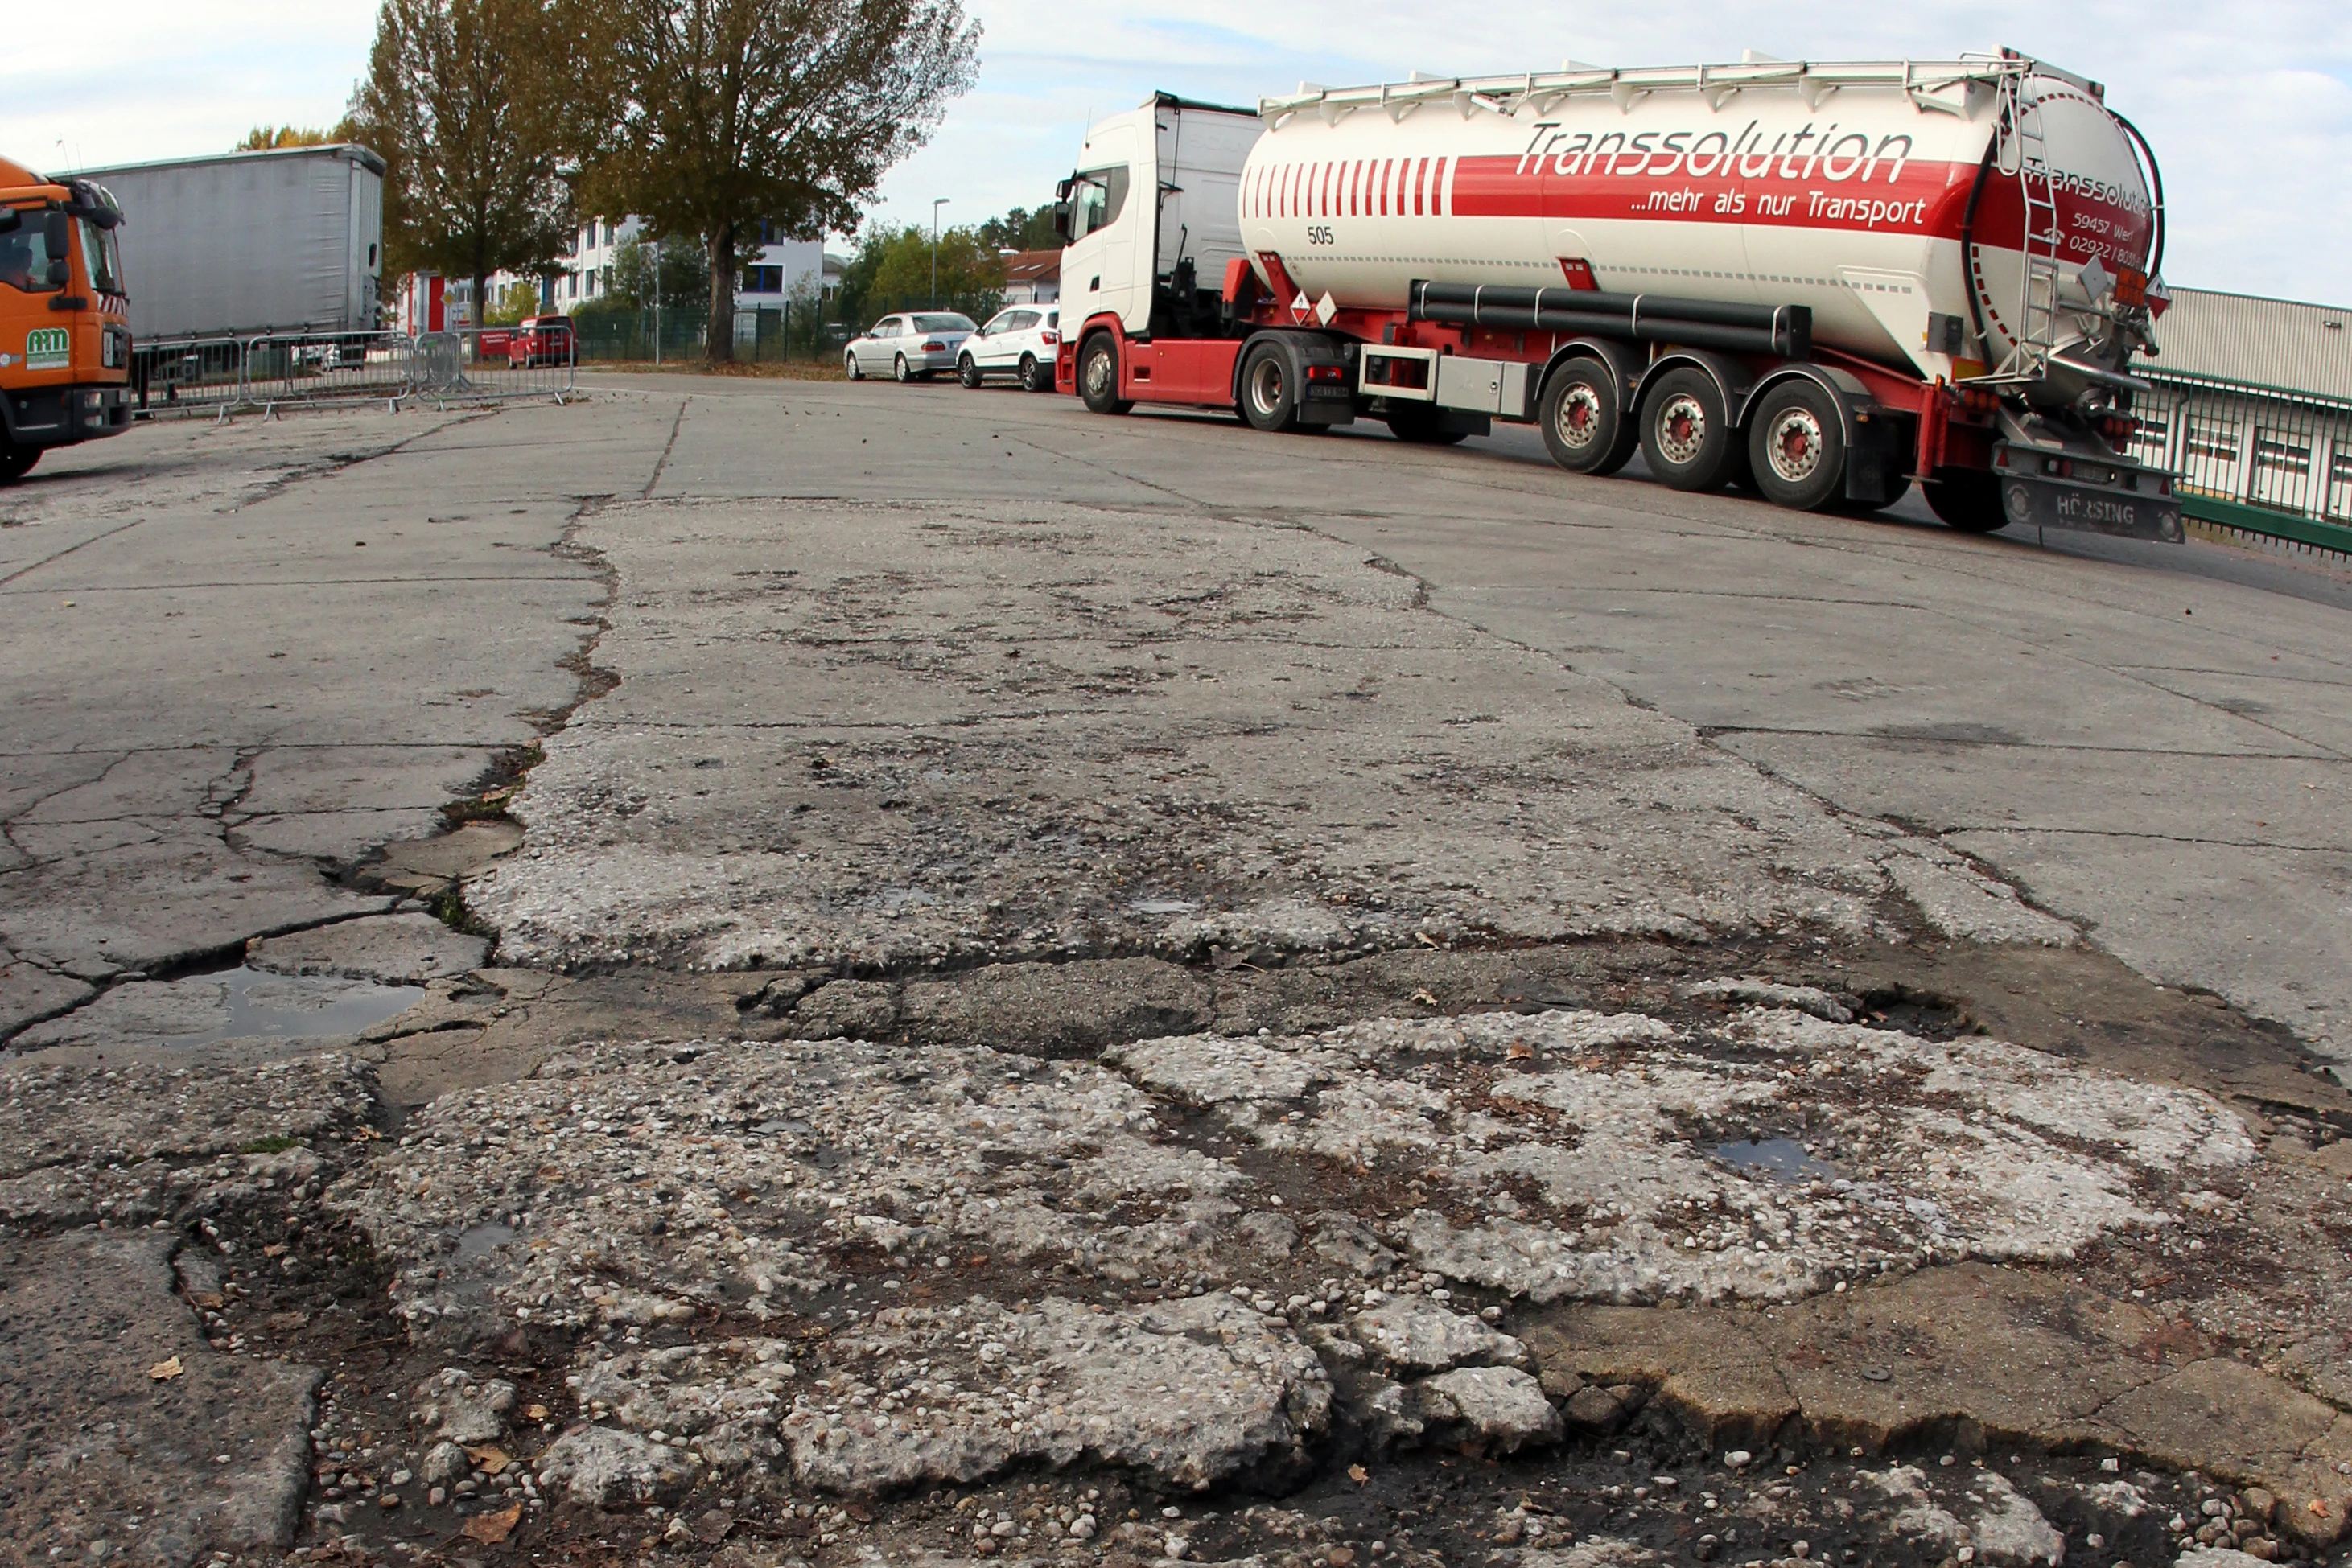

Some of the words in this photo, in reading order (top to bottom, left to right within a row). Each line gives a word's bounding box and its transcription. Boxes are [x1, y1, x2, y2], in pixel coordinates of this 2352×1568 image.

[1515, 119, 1914, 184] Transsolution
[1630, 187, 1704, 212] ...mehr
[1713, 187, 1745, 215] als
[1757, 194, 1797, 216] nur
[1808, 191, 1927, 228] Transport
[1308, 226, 1334, 245] 505
[2071, 212, 2110, 234] 59457
[2113, 224, 2134, 242] Werl
[2069, 236, 2111, 258] 02922
